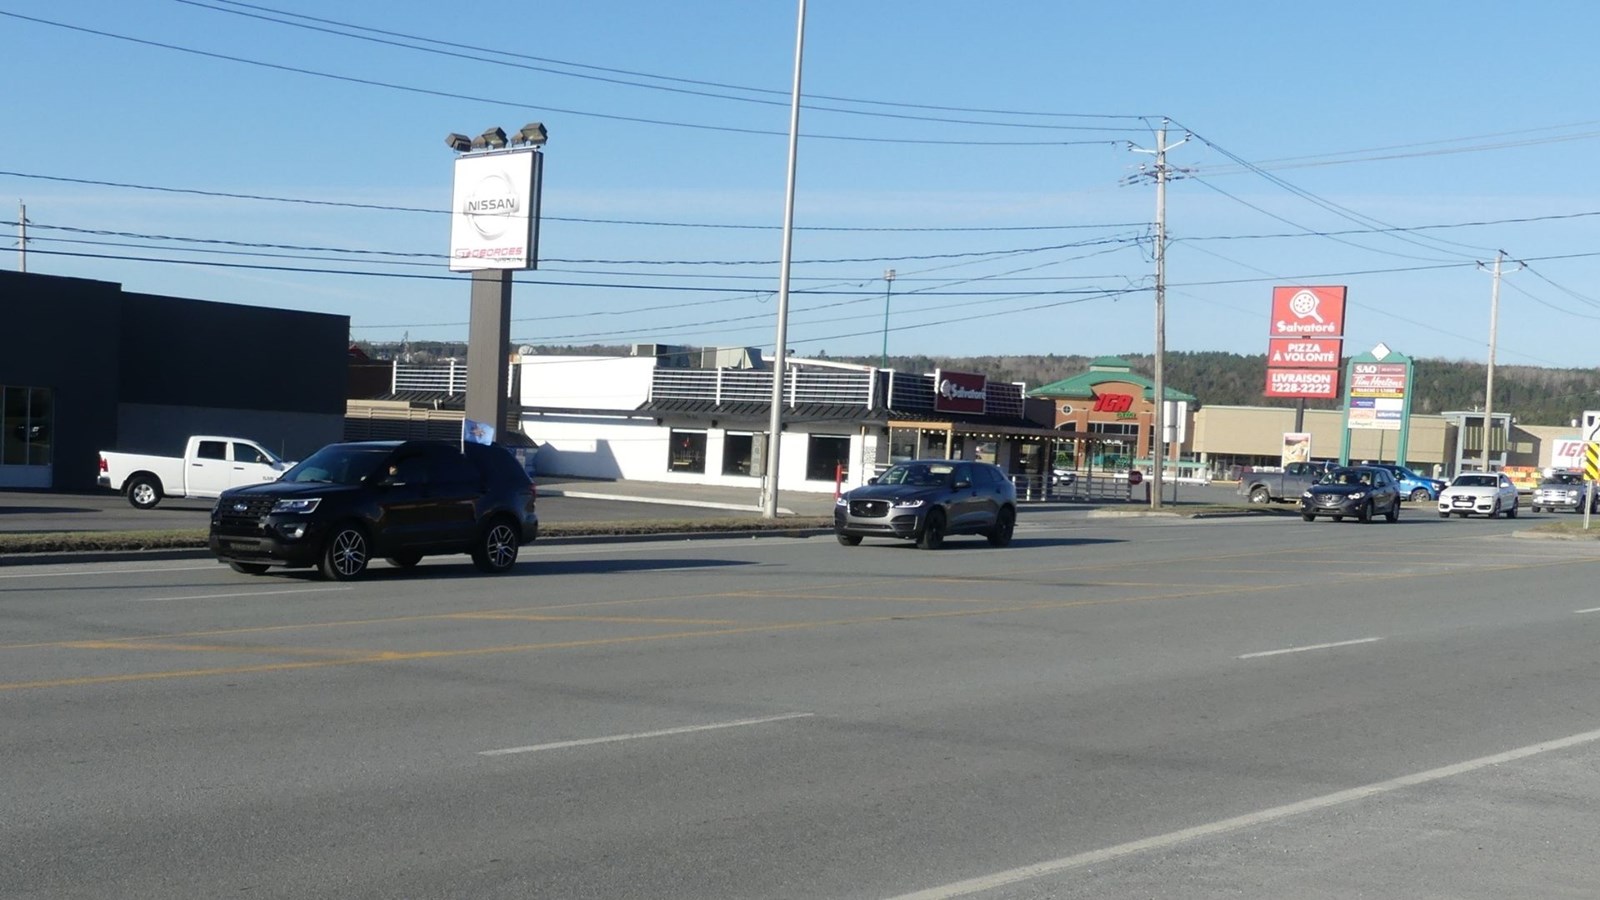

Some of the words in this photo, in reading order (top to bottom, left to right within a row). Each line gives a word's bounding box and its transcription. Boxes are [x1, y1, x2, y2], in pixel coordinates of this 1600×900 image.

[468, 198, 515, 211] NISSAN
[1277, 320, 1335, 332] Salvatoré
[1288, 343, 1320, 353] PIZZA
[1284, 351, 1334, 362] VOLONTÉ
[1272, 373, 1331, 384] LIVRAISON
[1093, 393, 1133, 413] IGA
